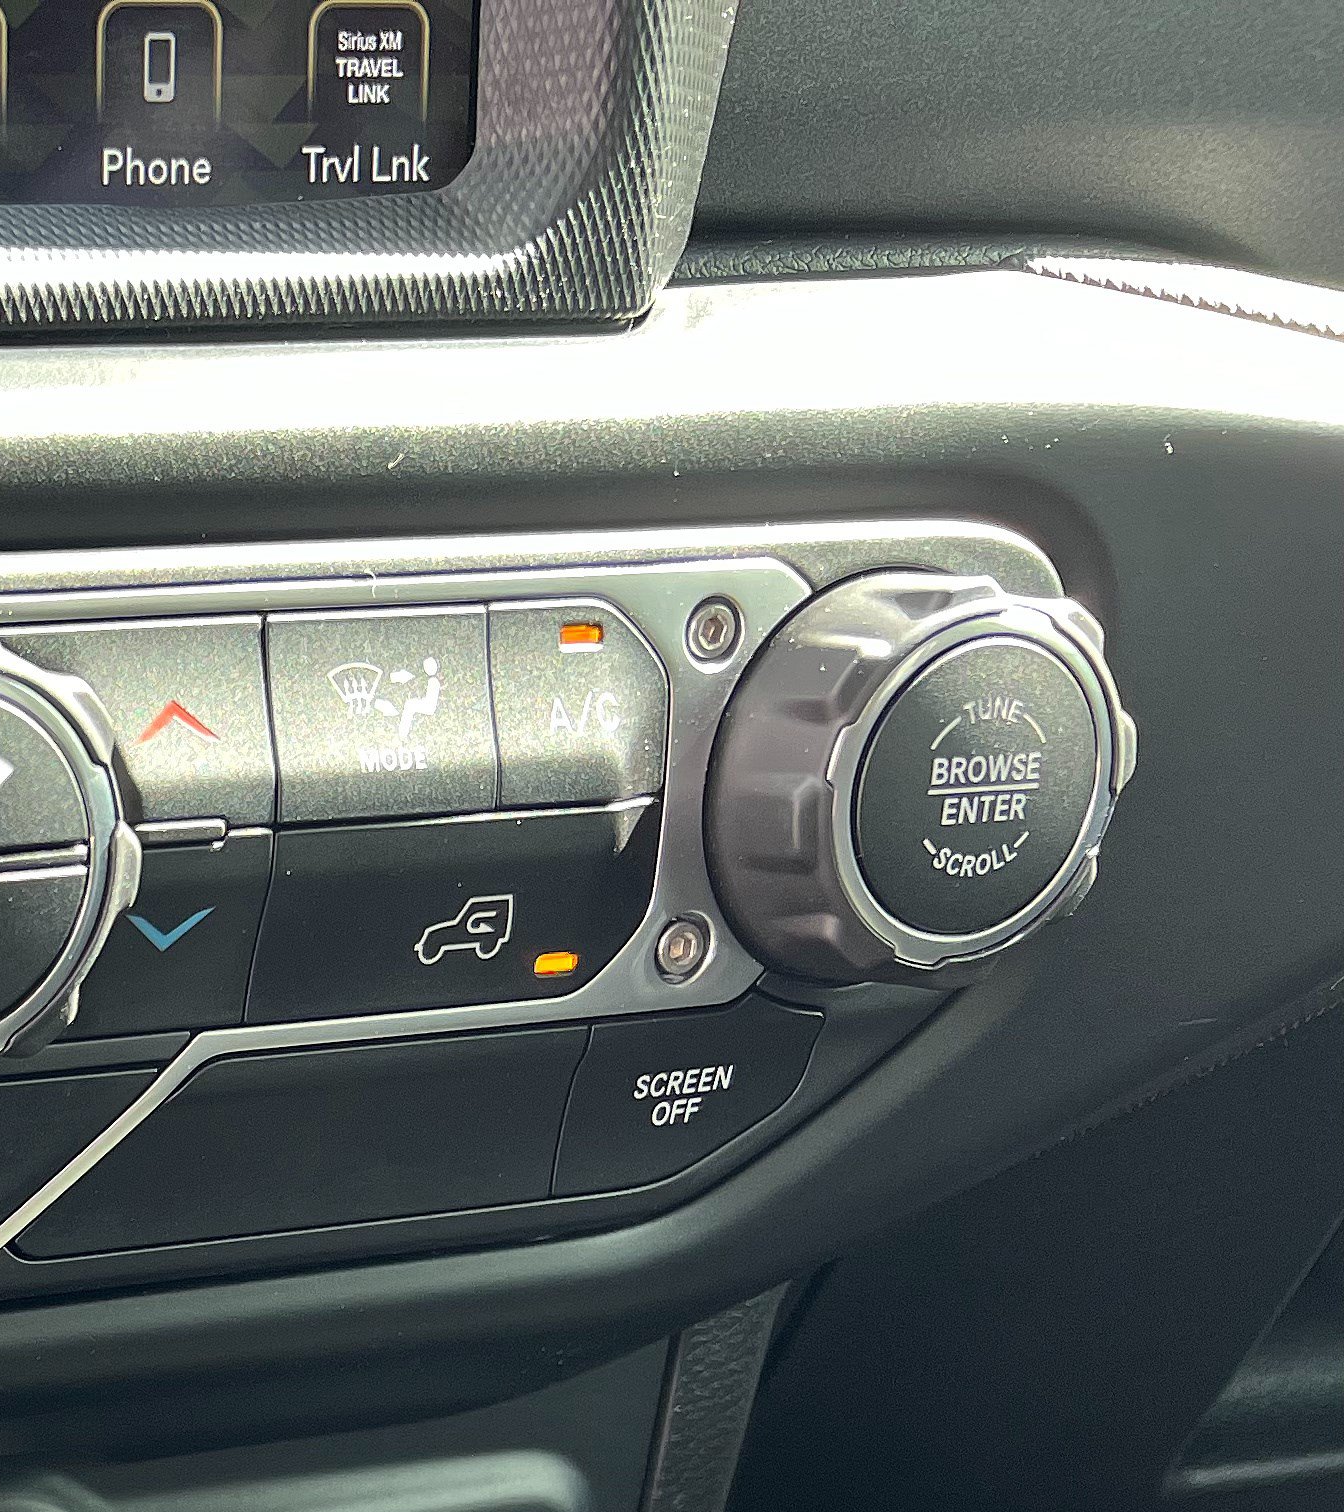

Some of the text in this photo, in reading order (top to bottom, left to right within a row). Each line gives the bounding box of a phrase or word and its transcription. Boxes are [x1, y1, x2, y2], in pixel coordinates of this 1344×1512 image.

[337, 31, 403, 52] Sirius XM
[335, 57, 404, 80] TRAVEL
[347, 83, 391, 105] LINK
[101, 146, 213, 187] Phone
[302, 145, 431, 184] Trvl Lnk
[548, 691, 622, 738] A/C
[963, 696, 1026, 726] TUNE
[358, 746, 429, 773] MODE
[930, 751, 1042, 786] BROWSE
[940, 792, 1029, 827] ENTER
[931, 843, 1019, 878] SCROLL
[633, 1063, 735, 1101] SCREEN
[651, 1098, 703, 1127] OFF
